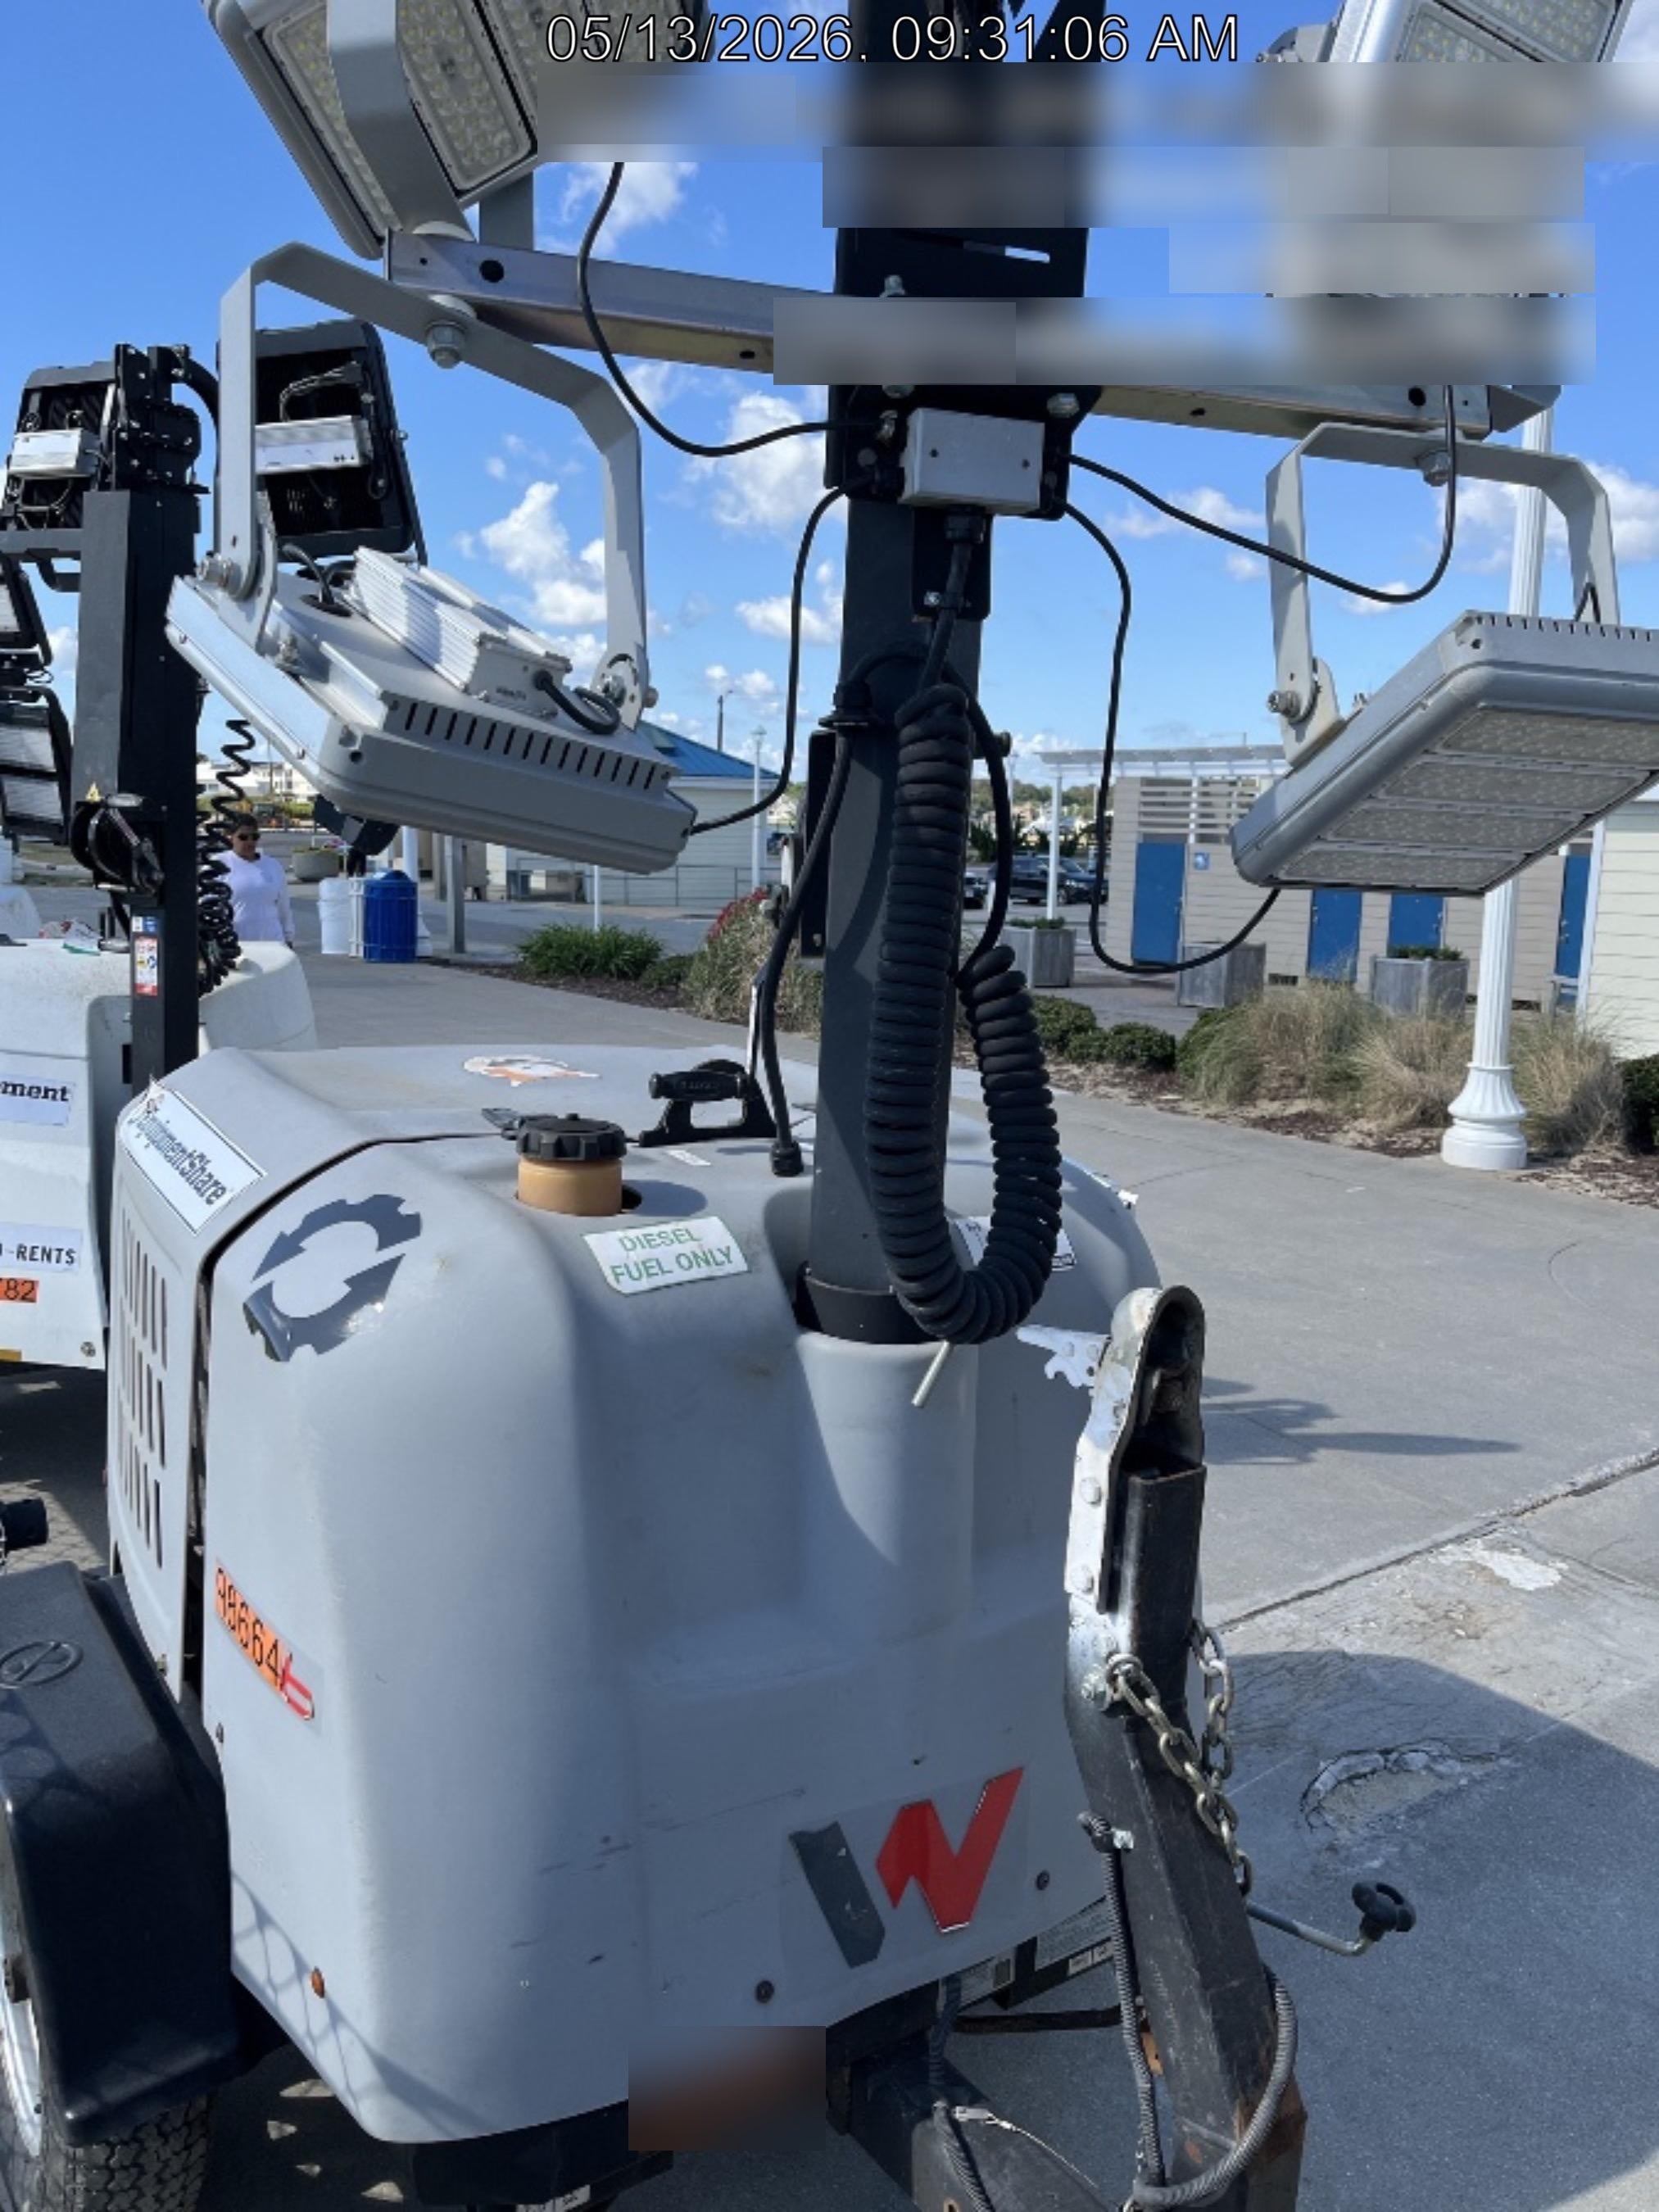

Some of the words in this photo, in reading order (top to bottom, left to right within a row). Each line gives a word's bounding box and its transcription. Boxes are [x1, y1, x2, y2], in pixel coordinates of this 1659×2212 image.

[619, 1227, 701, 1252] DIESEL
[610, 1258, 673, 1285] FUEL
[675, 1244, 733, 1271] ONLY
[0, 1278, 35, 1301] 82
